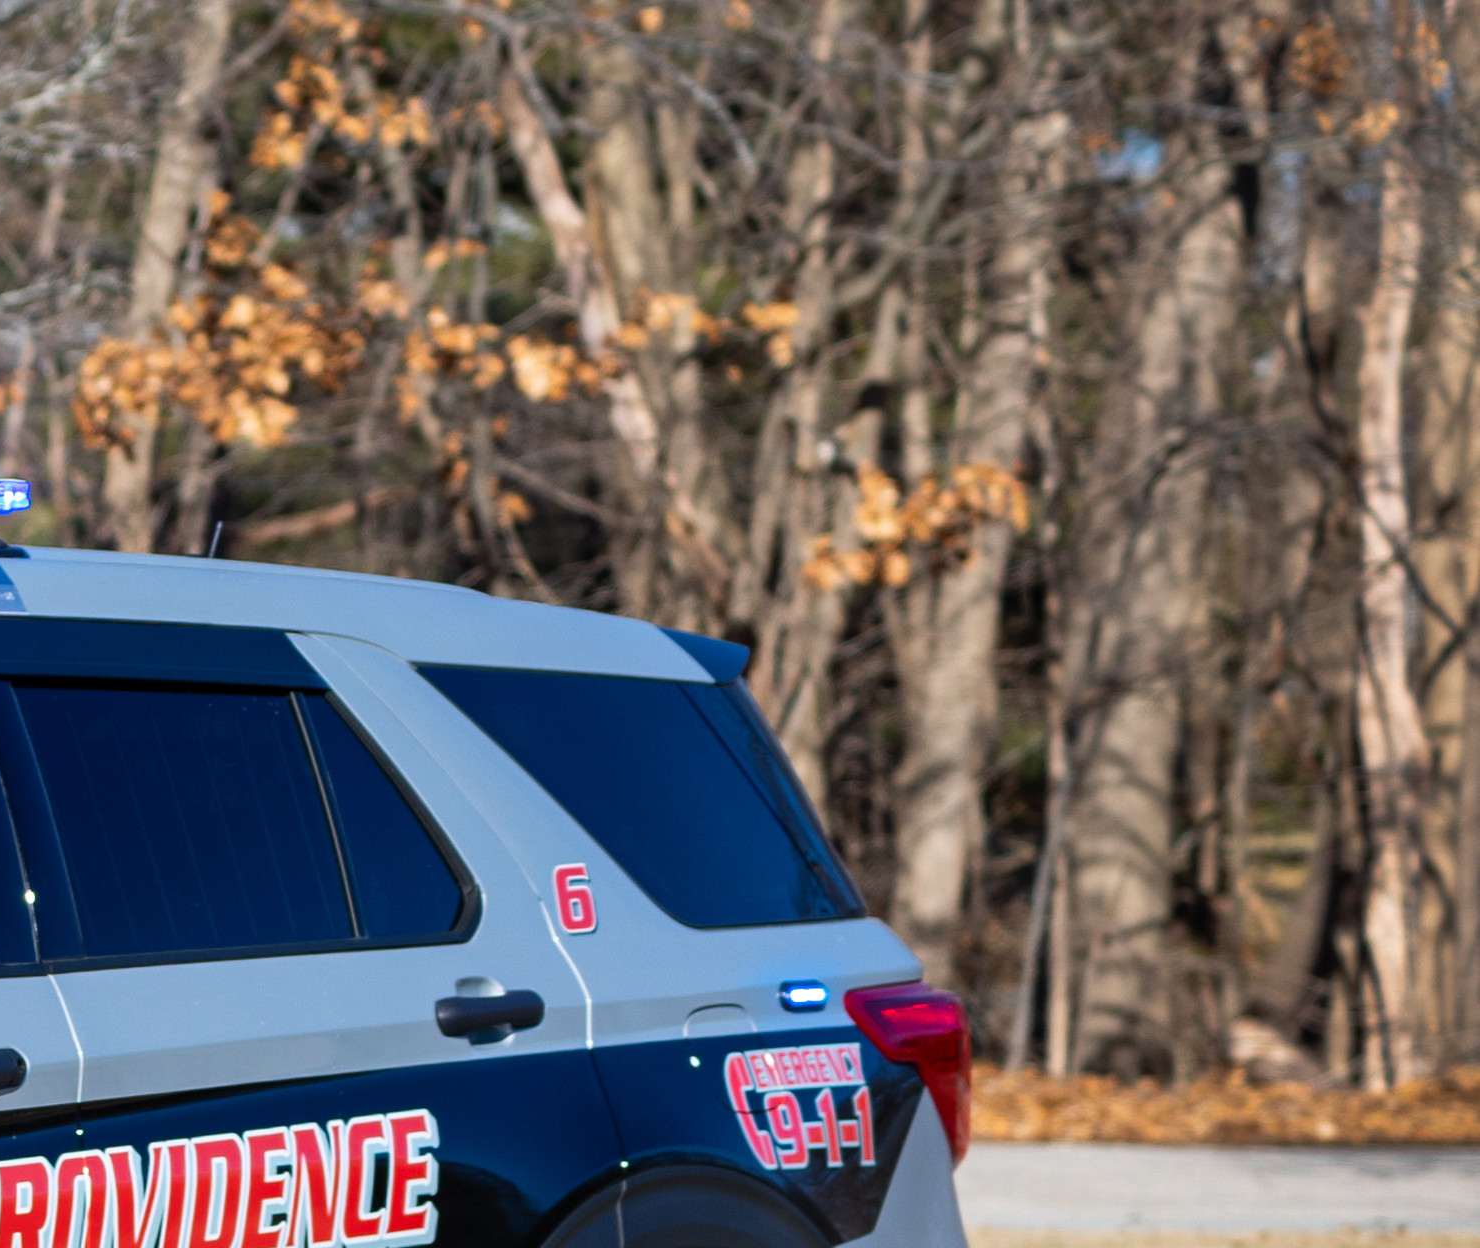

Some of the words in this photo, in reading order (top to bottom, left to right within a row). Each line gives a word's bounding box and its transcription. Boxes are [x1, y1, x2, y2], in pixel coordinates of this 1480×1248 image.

[553, 863, 597, 934] 6
[748, 1044, 865, 1090] EMERGENCY
[764, 1086, 877, 1169] 9-1-1
